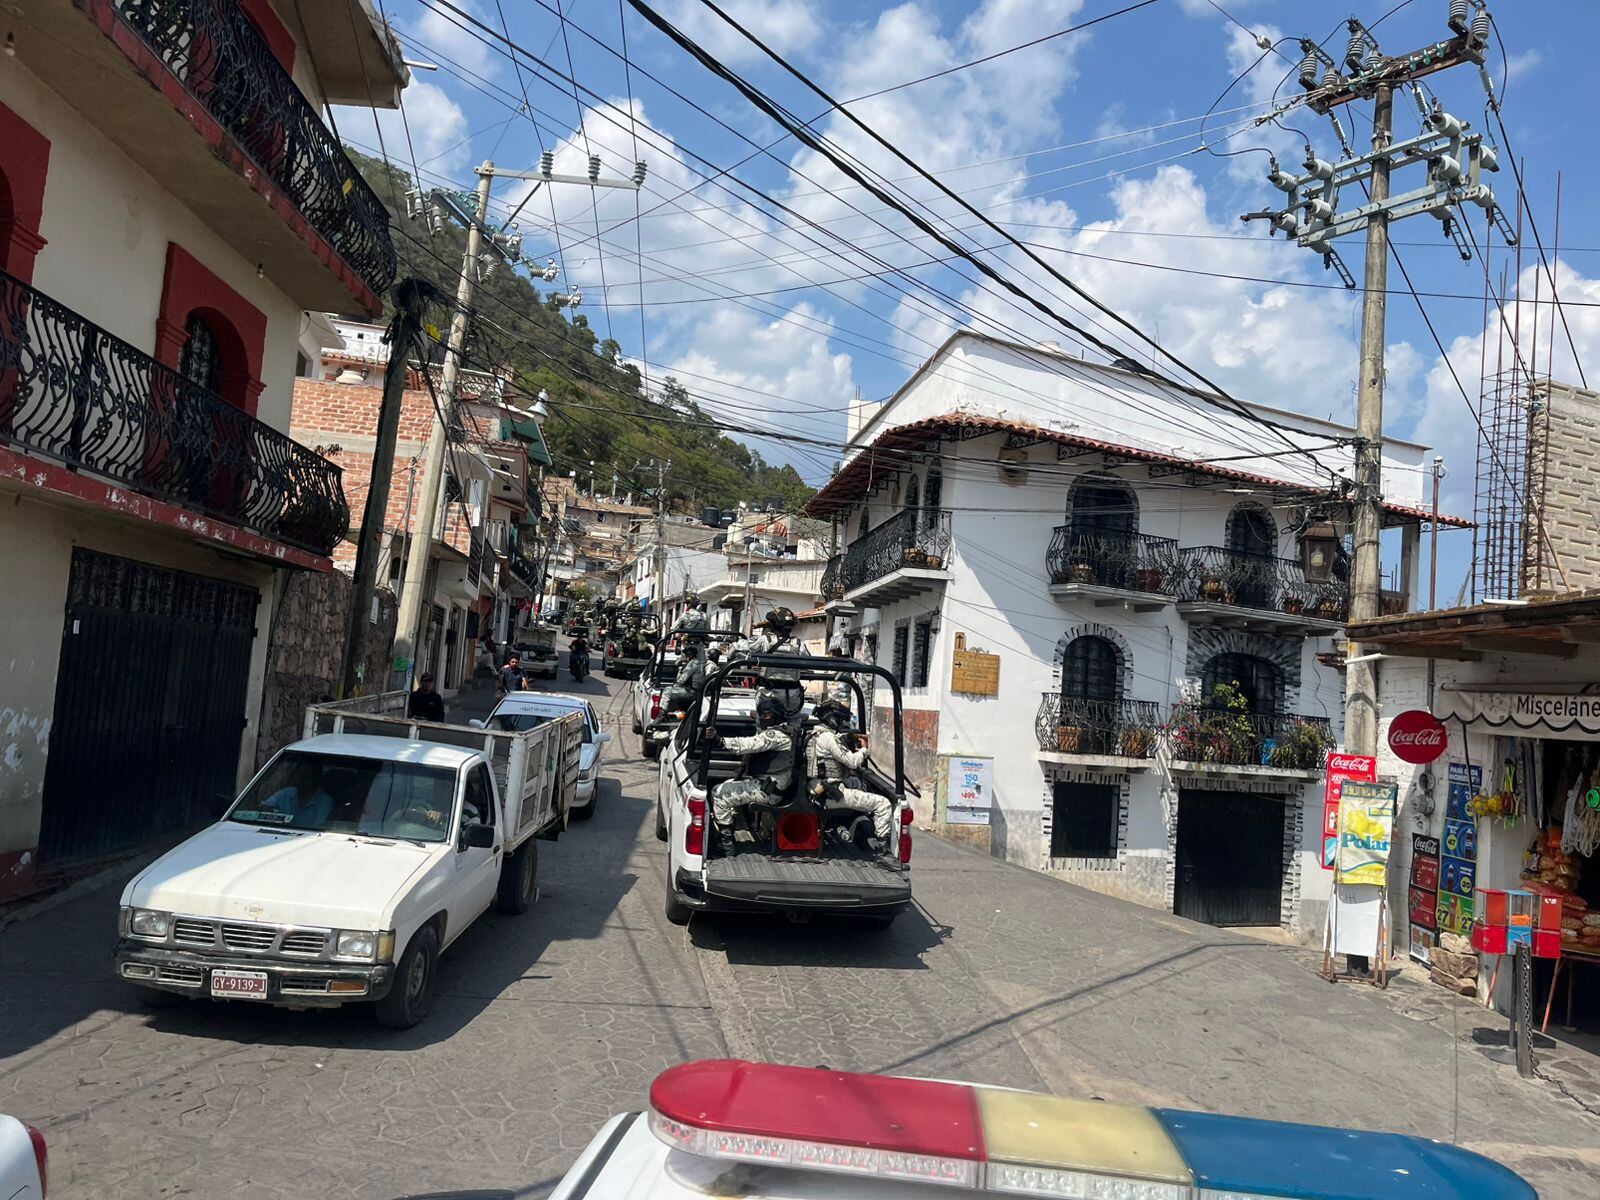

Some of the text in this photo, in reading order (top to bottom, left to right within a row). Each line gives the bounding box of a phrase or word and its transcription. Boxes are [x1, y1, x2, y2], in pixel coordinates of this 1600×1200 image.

[1390, 729, 1443, 746] Coca-Cola
[1330, 756, 1371, 771] Coca-Cola
[964, 773, 978, 782] 150
[1464, 768, 1479, 777] CDA
[1341, 831, 1389, 851] Polar
[1414, 836, 1437, 855] Coca-Cola
[1437, 908, 1449, 923] 27
[1462, 916, 1473, 931] 27
[213, 977, 265, 992] GY-9139-J
